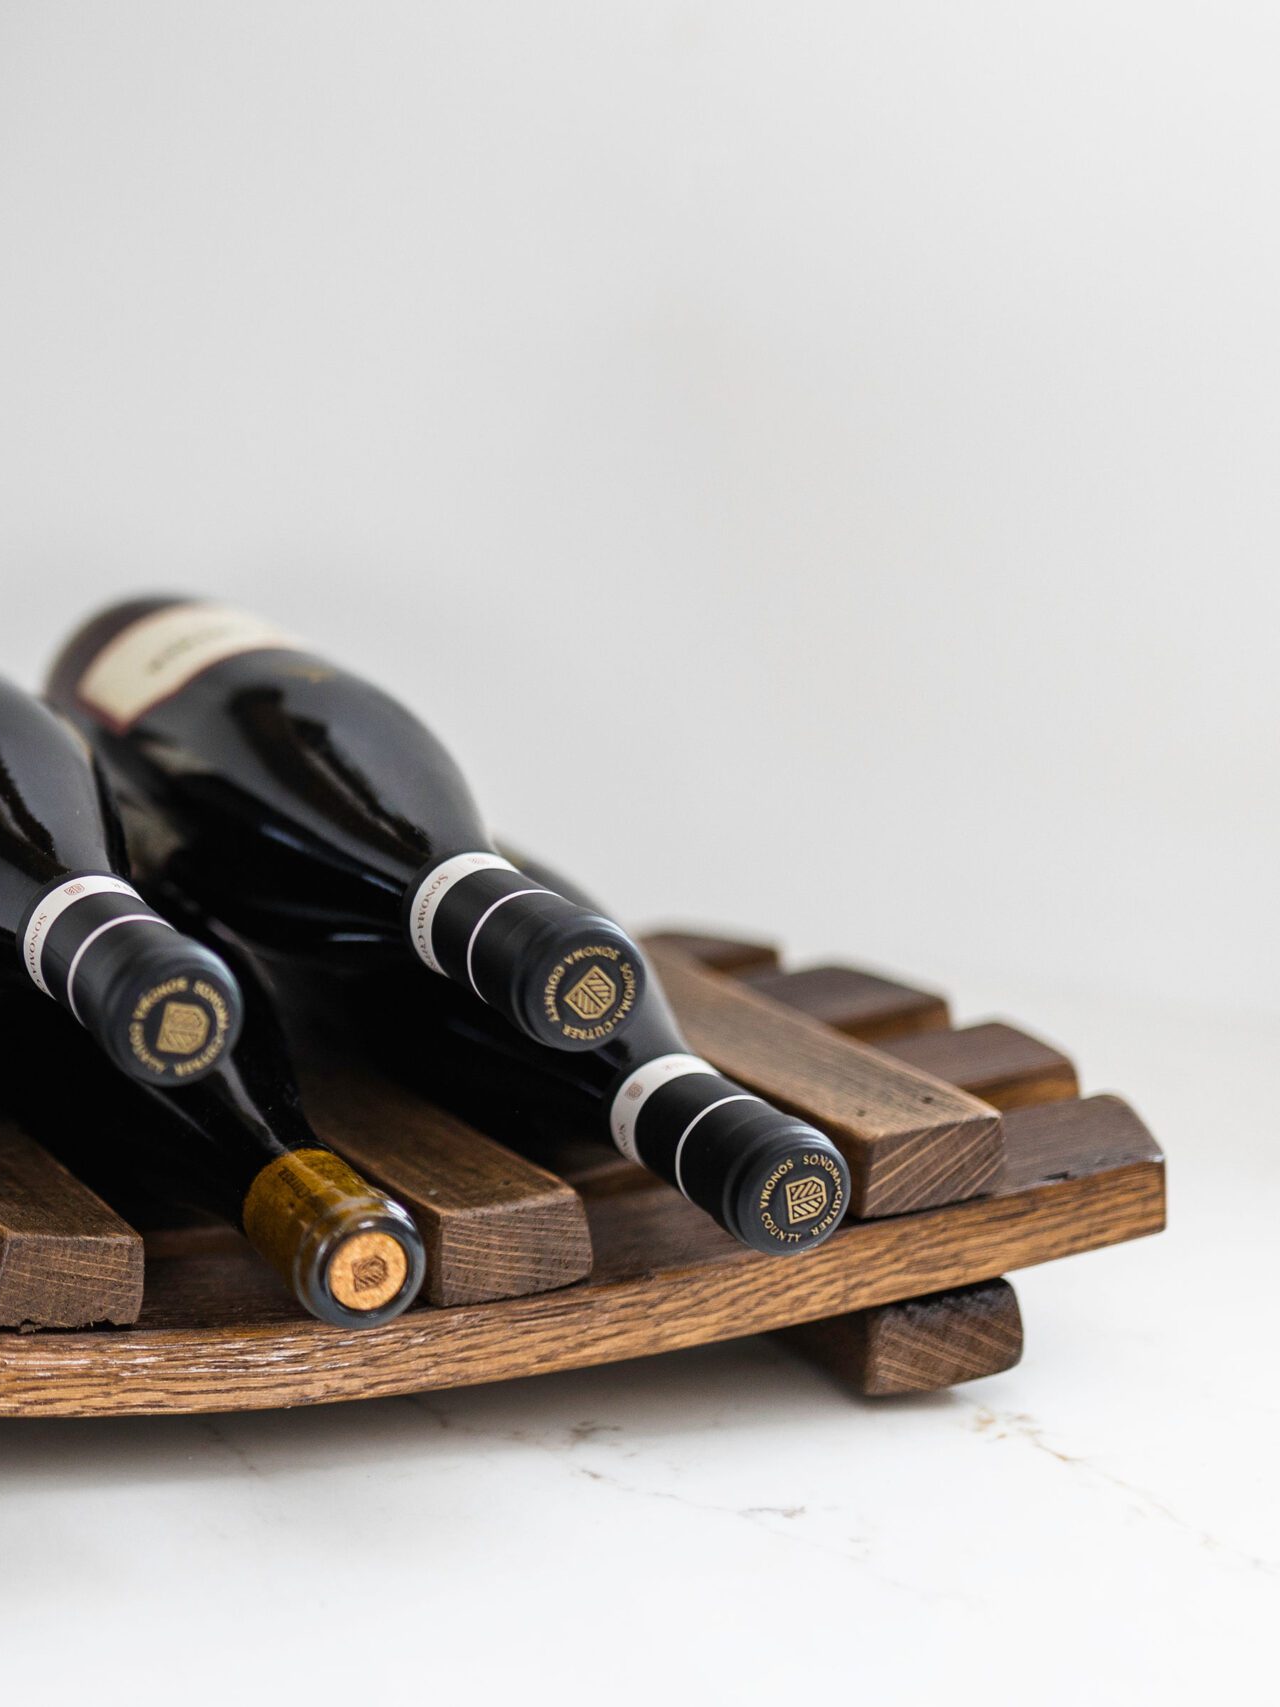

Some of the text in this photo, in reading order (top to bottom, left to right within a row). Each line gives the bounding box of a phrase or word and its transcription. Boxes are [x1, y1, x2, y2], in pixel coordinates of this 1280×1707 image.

[564, 945, 621, 966] SONOMA
[759, 1158, 802, 1243] SONOMA COUNTY
[802, 1153, 844, 1237] SONOMA-CUTRER
